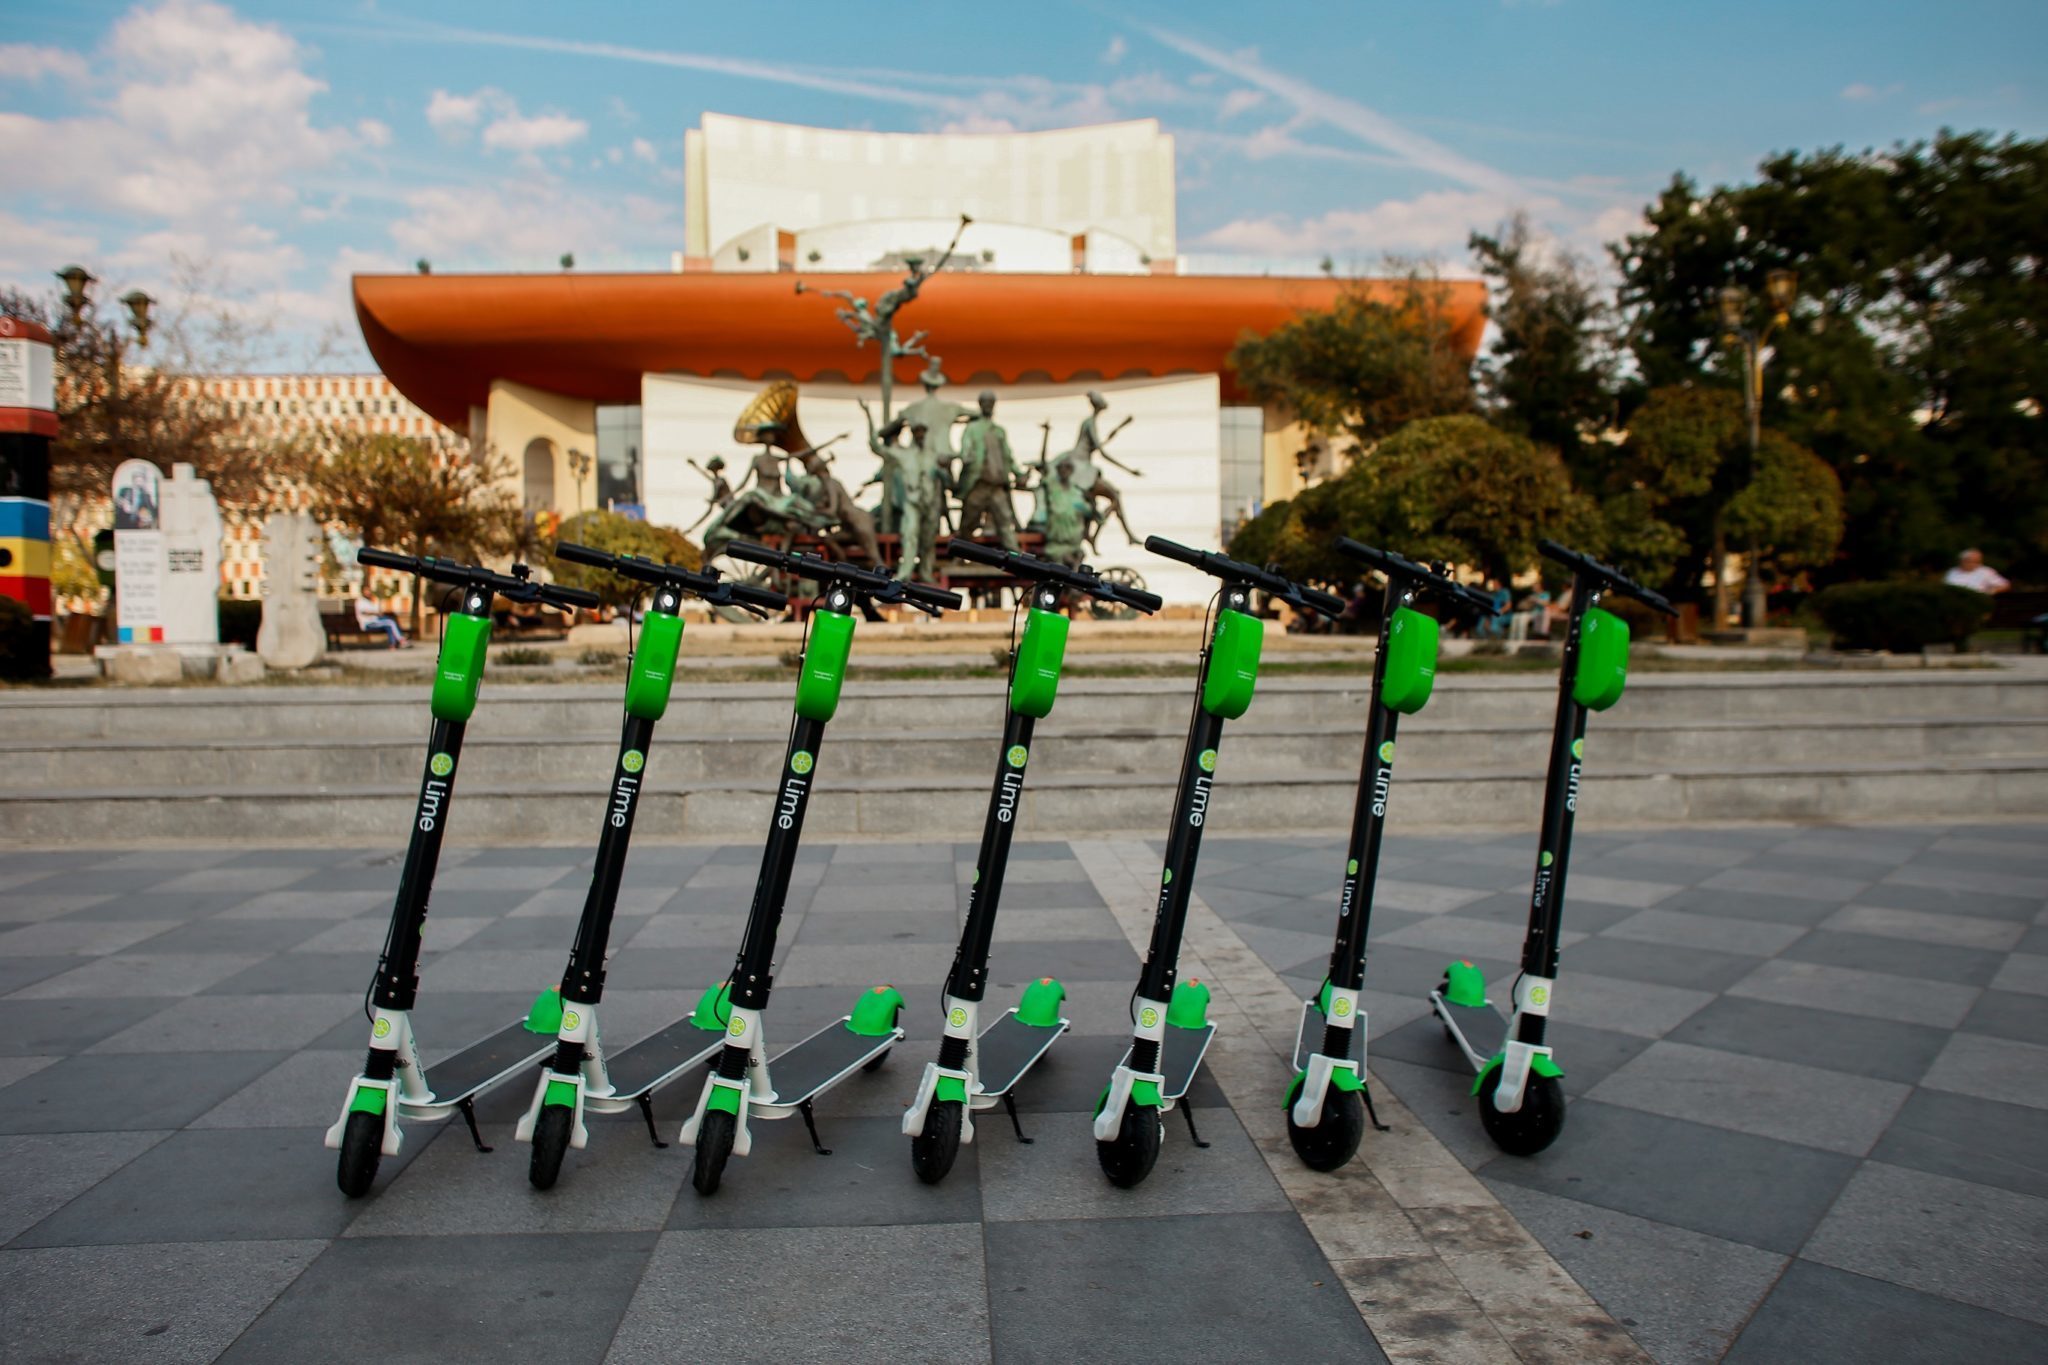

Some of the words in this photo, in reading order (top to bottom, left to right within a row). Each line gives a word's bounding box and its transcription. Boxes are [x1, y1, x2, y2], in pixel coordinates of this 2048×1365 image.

[419, 781, 447, 832] Lime
[611, 777, 638, 828] Lime
[778, 778, 807, 829] Lime
[997, 772, 1023, 822] Lime
[1189, 777, 1213, 827] Lime
[1372, 768, 1392, 817] Lime
[1340, 879, 1357, 917] Lime
